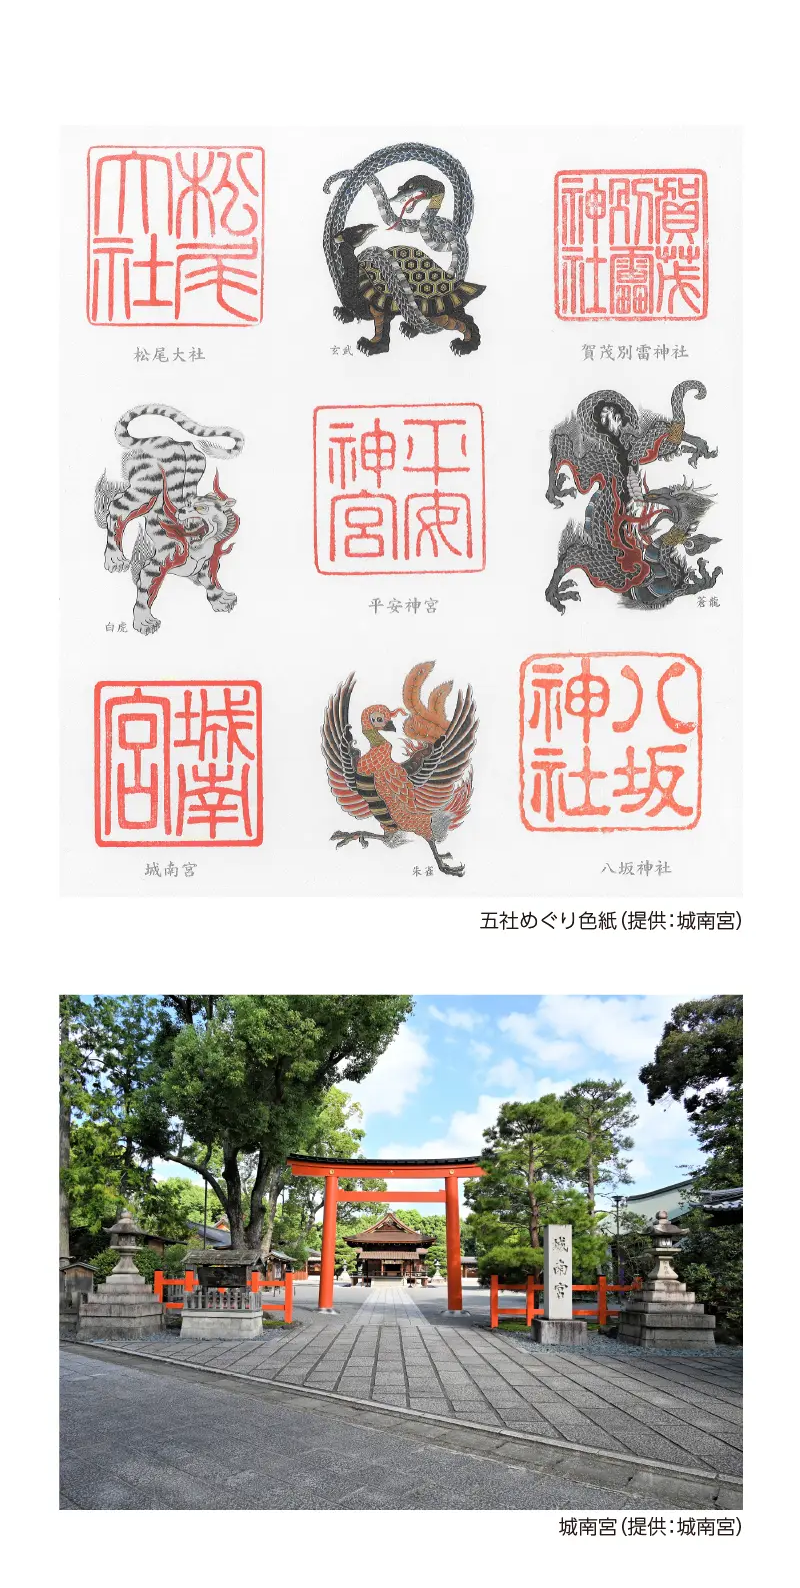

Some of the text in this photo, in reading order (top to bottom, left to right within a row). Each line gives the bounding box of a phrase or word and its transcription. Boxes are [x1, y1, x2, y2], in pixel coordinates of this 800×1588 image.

[133, 346, 206, 363] 松尾大社
[329, 344, 354, 357] 玄武
[580, 343, 689, 362] 賀茂別雷神社
[367, 597, 440, 615] 平安神宮
[696, 595, 721, 608] 蒼龍
[104, 621, 129, 634] 白虎
[144, 861, 198, 878] 城南宮
[411, 865, 434, 878] 朱雀
[600, 859, 672, 877] 八坂神社
[552, 1236, 569, 1300] 城南宮
